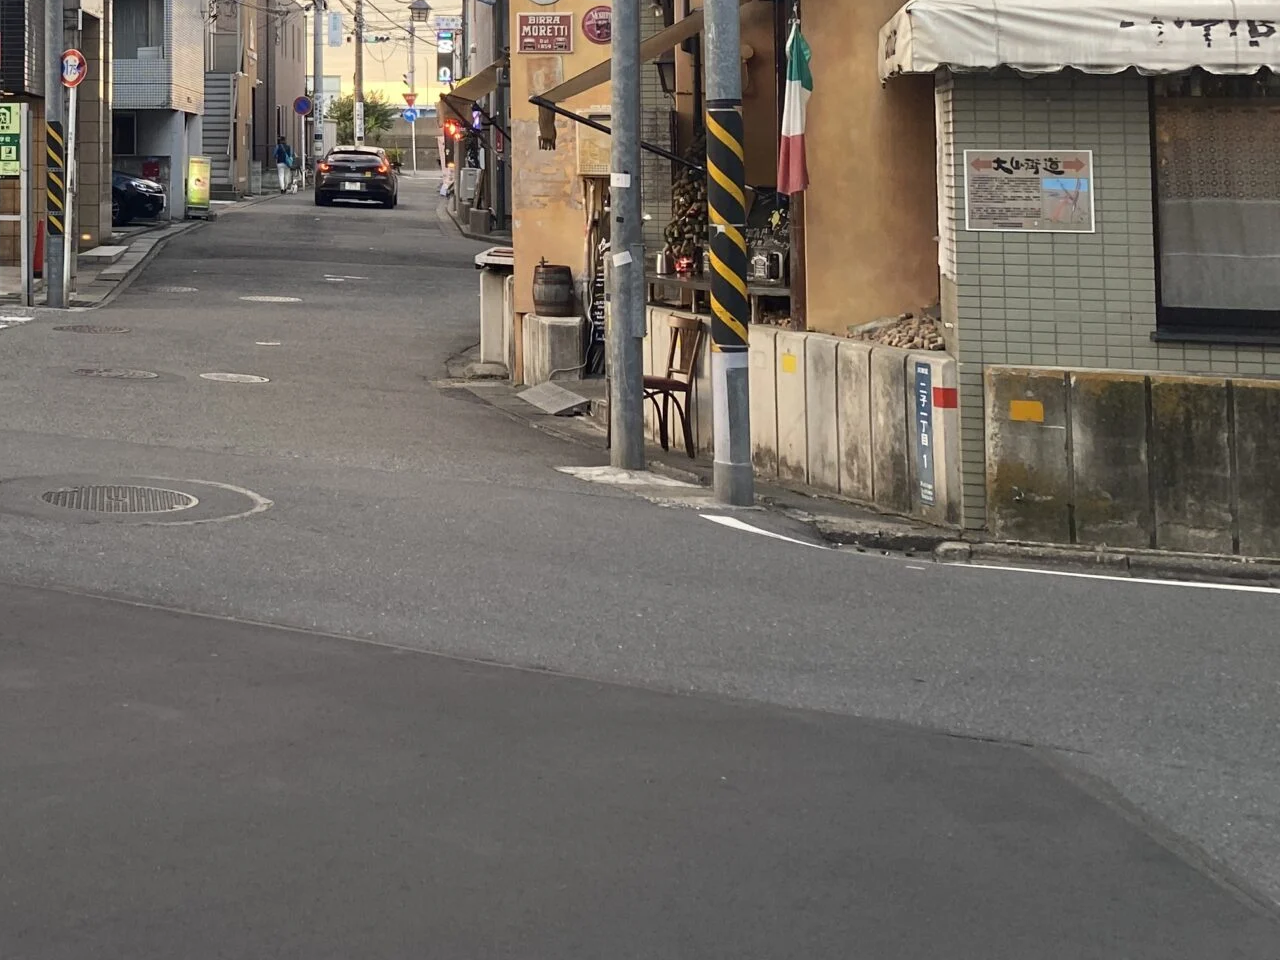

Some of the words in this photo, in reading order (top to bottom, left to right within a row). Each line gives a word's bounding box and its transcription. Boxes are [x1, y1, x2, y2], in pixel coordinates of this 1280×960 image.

[528, 16, 560, 24] BIRRA
[521, 25, 568, 36] MORETTI
[992, 157, 1065, 175] 大山街道
